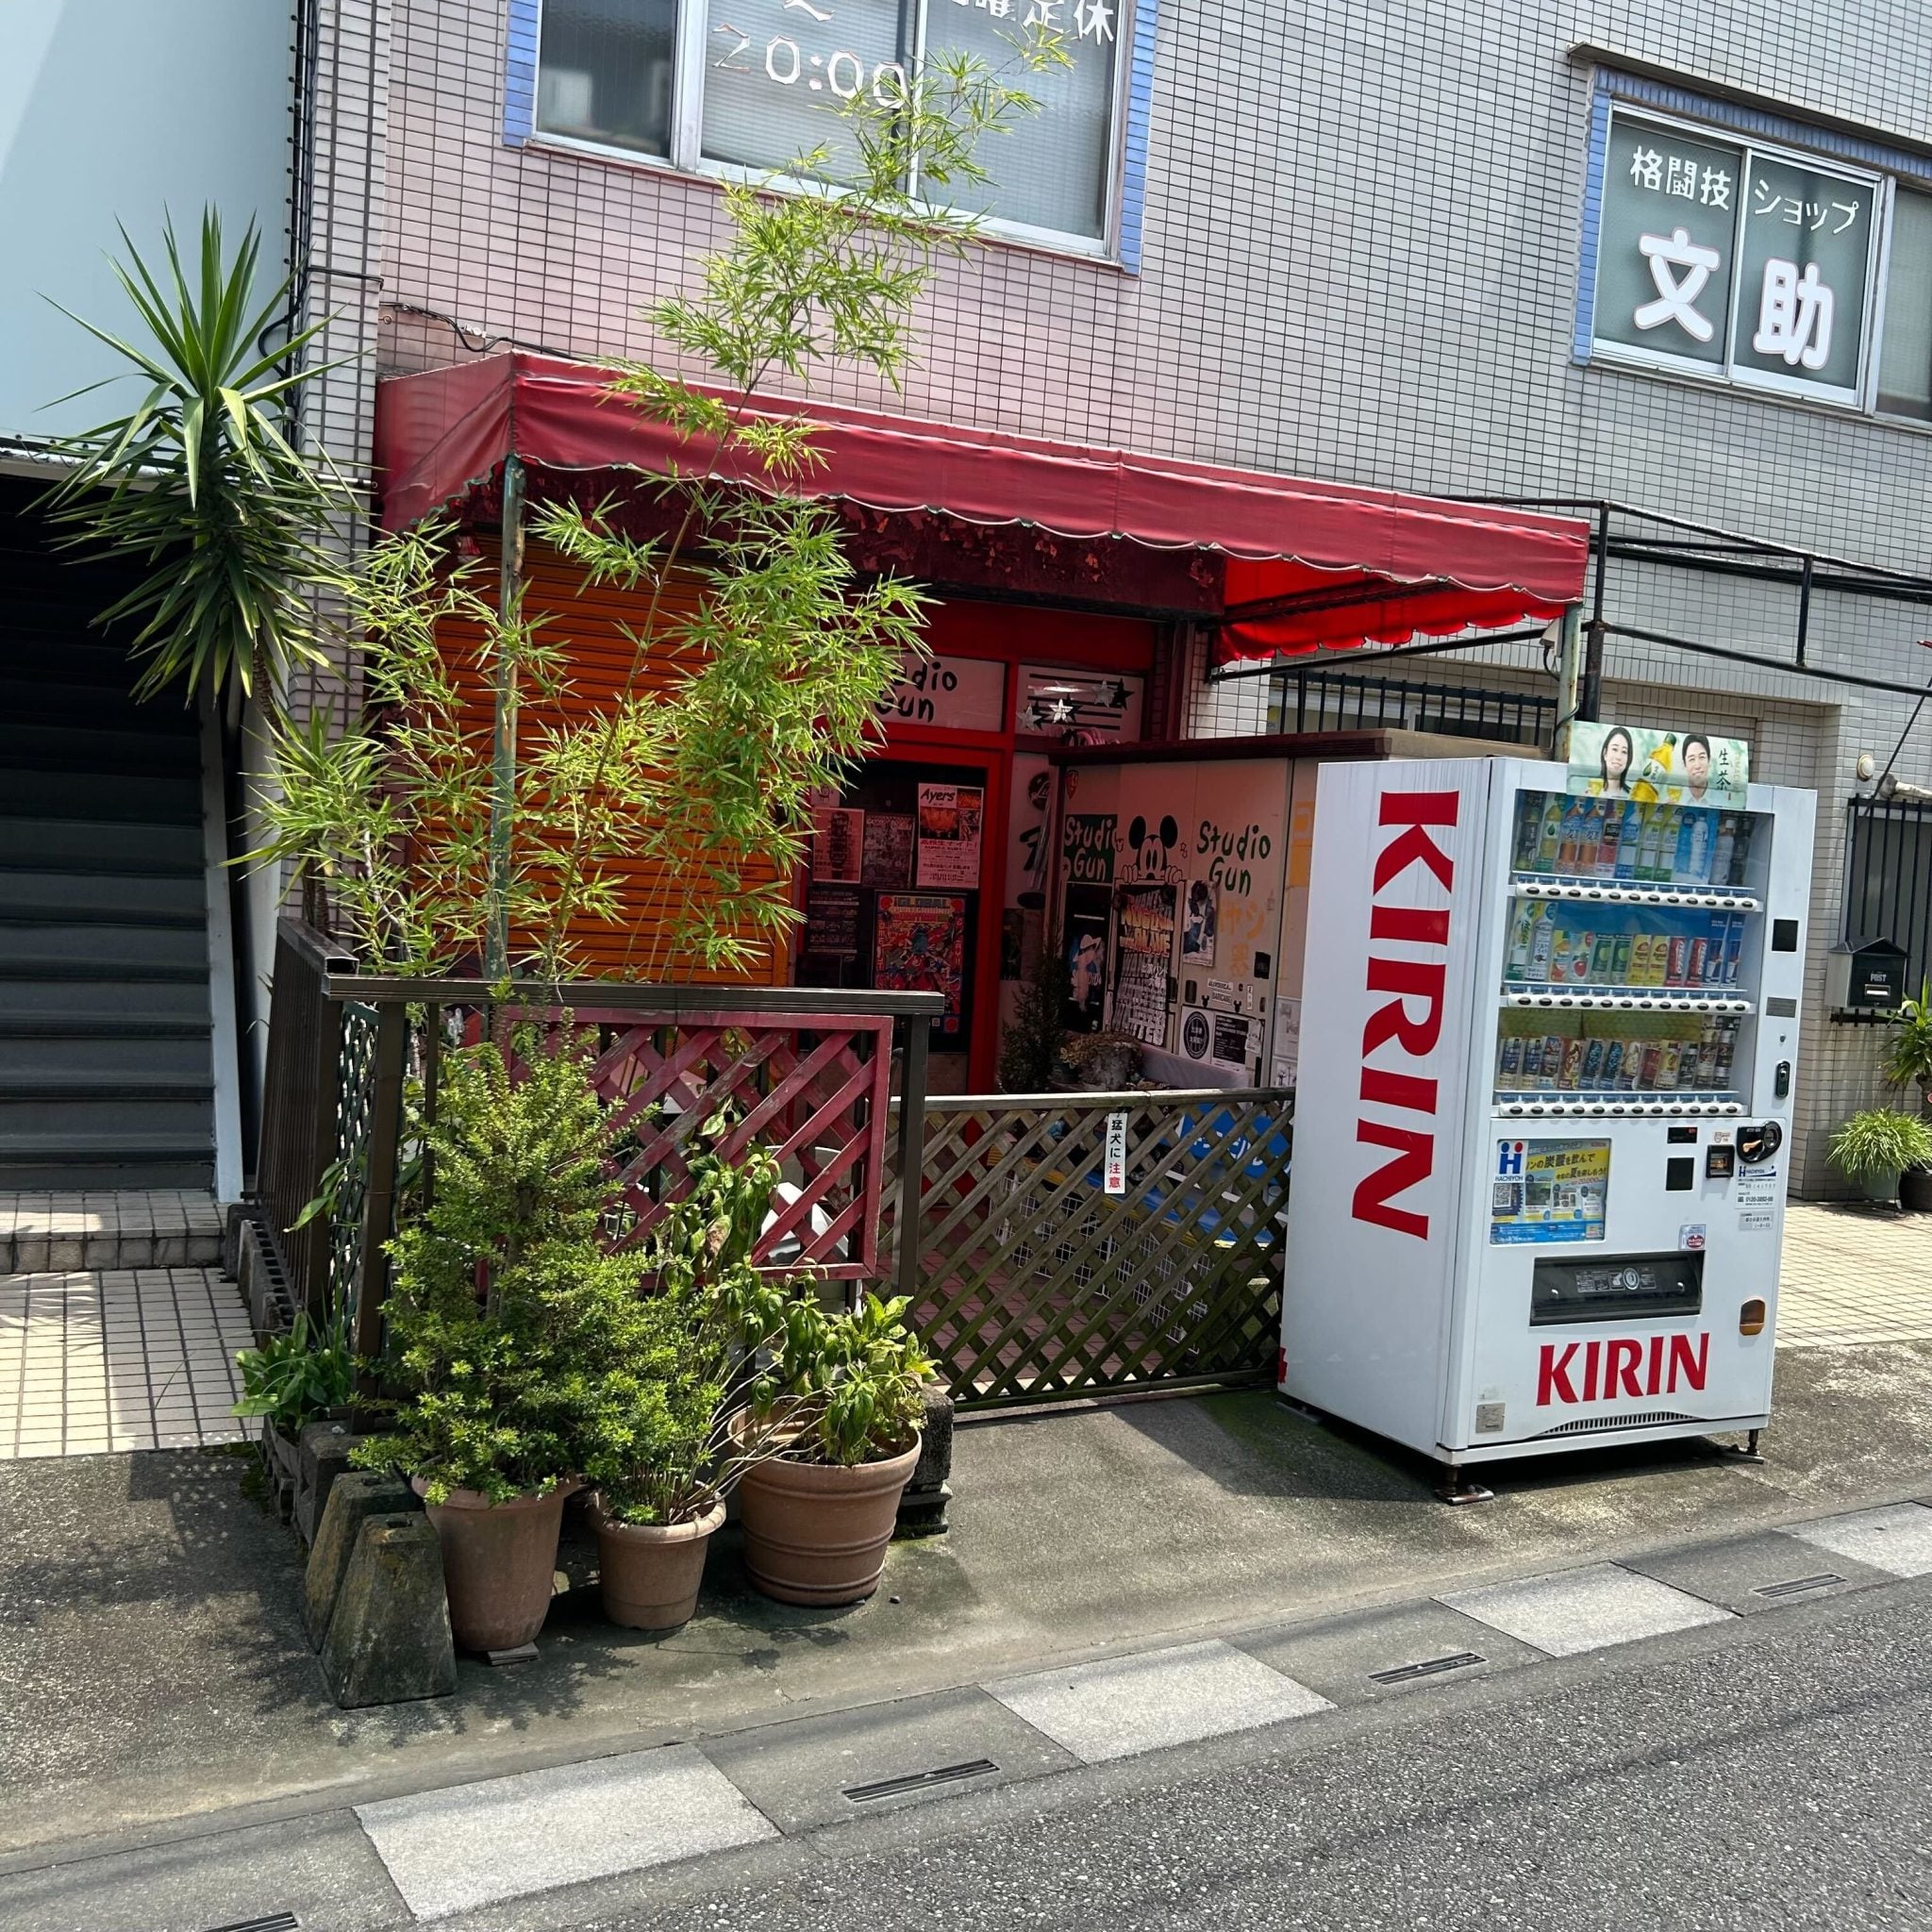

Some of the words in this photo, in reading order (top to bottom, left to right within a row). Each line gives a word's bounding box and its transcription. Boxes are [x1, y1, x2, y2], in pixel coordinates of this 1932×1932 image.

[711, 22, 908, 109] 20:00
[1629, 144, 1731, 211] 格闘技
[1754, 178, 1859, 235] ショップ
[1633, 226, 1835, 371] 文助
[891, 661, 958, 692] udio
[920, 788, 957, 803] Ayers
[1715, 747, 1732, 791] 生茶
[1074, 847, 1107, 882] Gun
[1196, 820, 1272, 862] Studio
[1208, 856, 1252, 897] Gun
[1351, 790, 1460, 1241] KIRIN
[1108, 1119, 1124, 1189] 猛犬に注意
[1536, 1332, 1710, 1407] KIRIN
